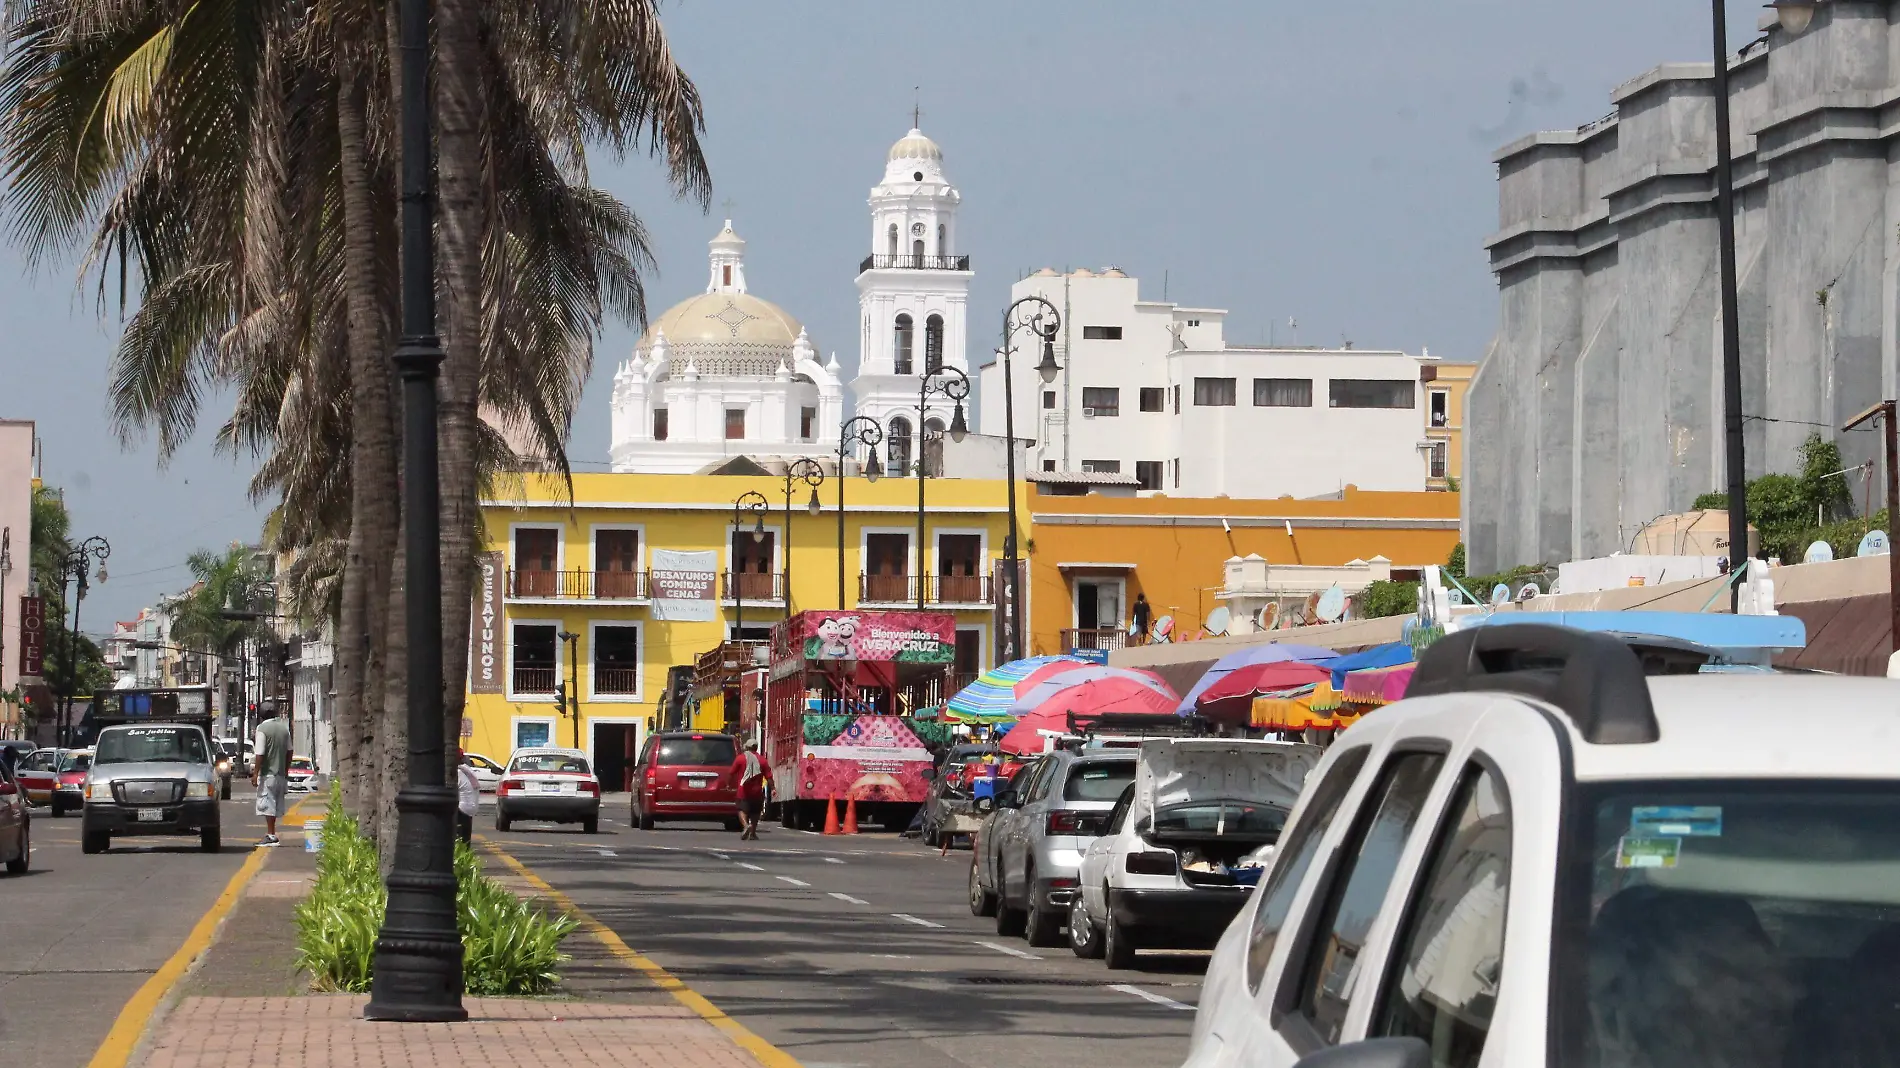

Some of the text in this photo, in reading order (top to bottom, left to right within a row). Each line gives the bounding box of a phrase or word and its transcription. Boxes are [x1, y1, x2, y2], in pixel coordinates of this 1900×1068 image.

[652, 571, 715, 581] DESAYUNOS
[660, 580, 708, 590] COMIDAS
[666, 589, 701, 599] CENAS
[481, 564, 494, 680] DESAYUNOS
[25, 601, 40, 673] HOTEL
[871, 629, 940, 640] Bienvenidos a
[862, 639, 940, 652] ¡VERACRUZ!
